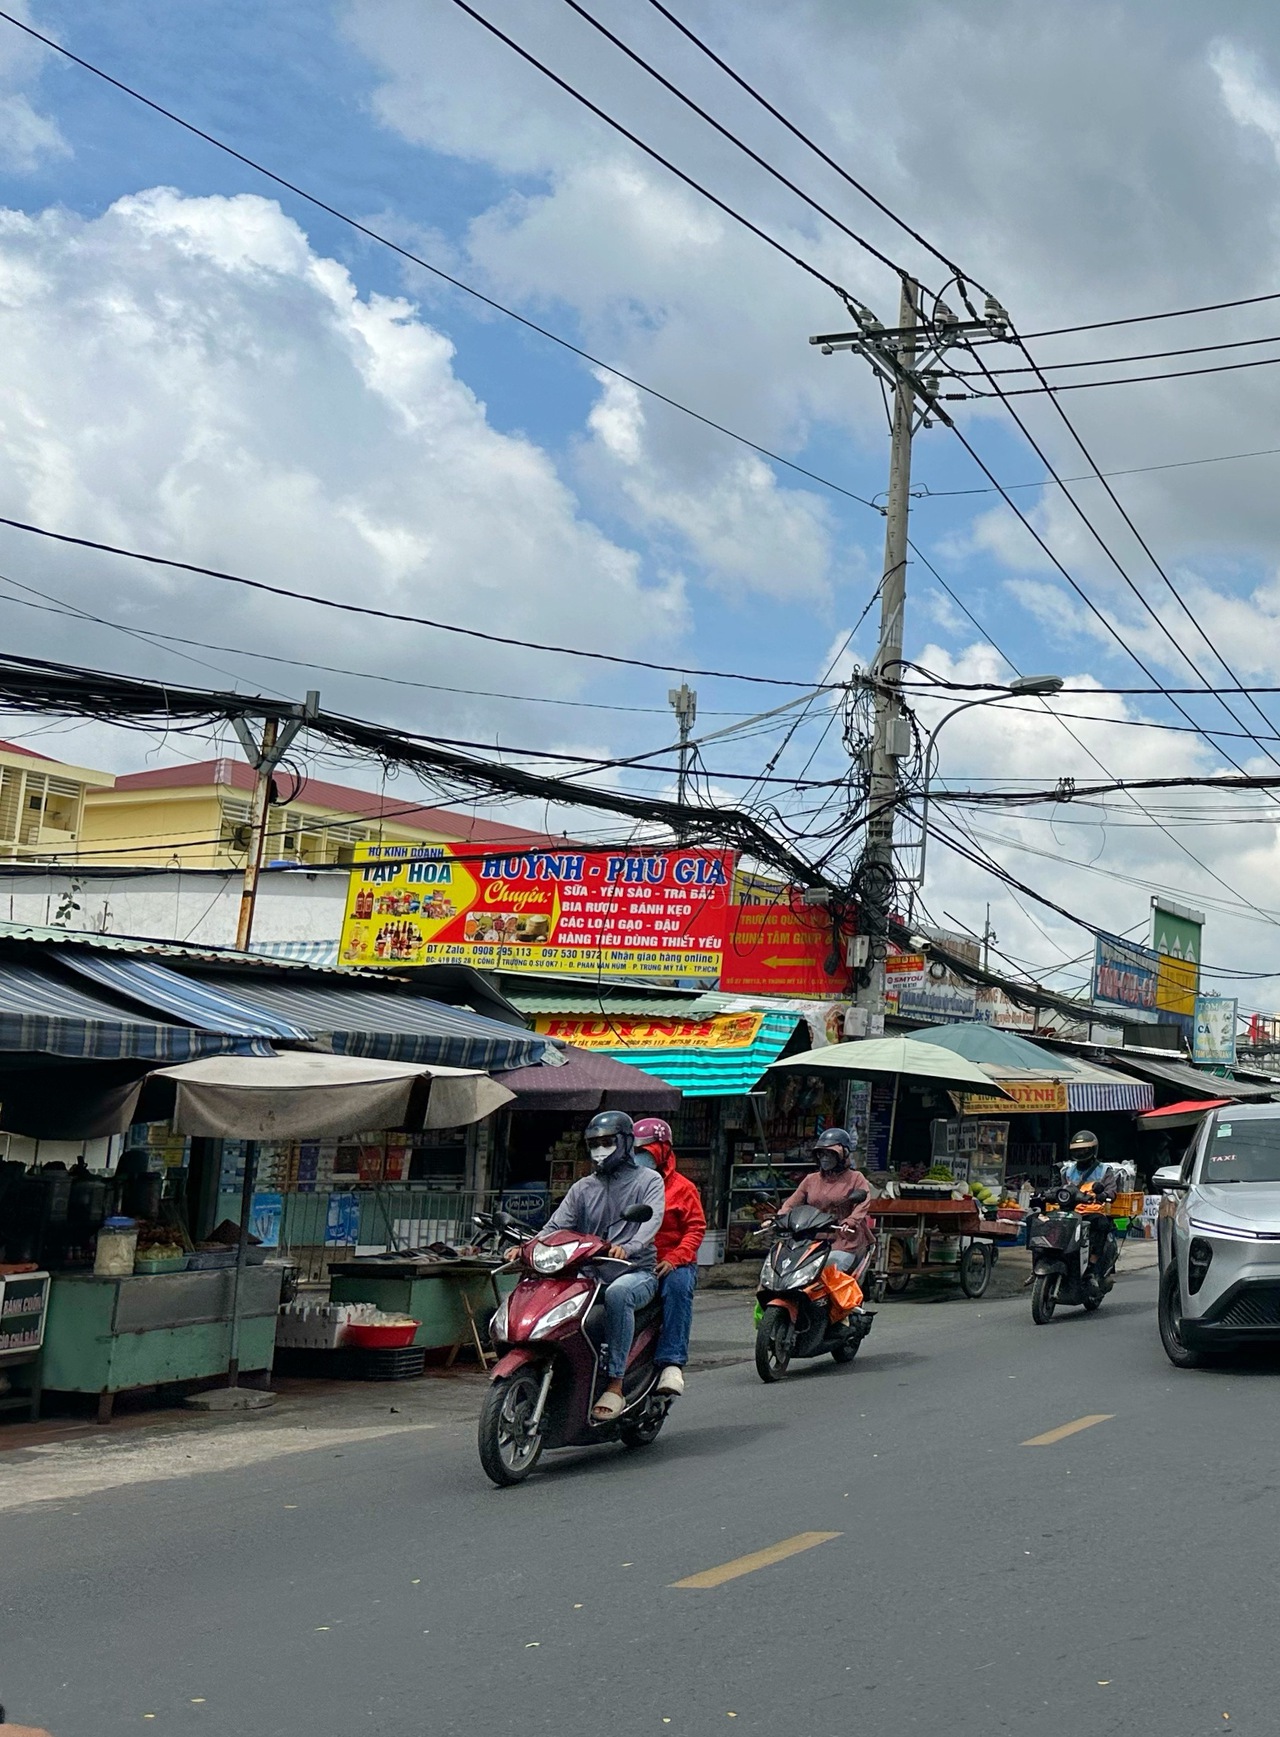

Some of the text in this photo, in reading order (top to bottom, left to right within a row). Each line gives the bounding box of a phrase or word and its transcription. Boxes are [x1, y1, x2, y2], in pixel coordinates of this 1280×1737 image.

[384, 847, 408, 858] KINH
[410, 847, 444, 859] DOANH
[362, 862, 403, 886] TẠP
[481, 847, 586, 882] HUỲNH
[674, 857, 729, 886] GIA
[484, 880, 551, 912] Chuyên:
[563, 883, 588, 897] SỮA
[600, 884, 622, 898] YẾN
[627, 885, 652, 899] SÀO
[663, 886, 687, 900] TRÀ
[562, 901, 692, 918] BIA RƯỢU BÁNH KẸO
[560, 916, 680, 934] CÁC LOẠI GẠO ĐẬU
[558, 931, 722, 949] HÀNG TIÊU DÙNG THIẾT YẾU
[729, 932, 764, 945] TRUNG
[767, 930, 790, 945] TÂM
[427, 945, 713, 963] ĐT Zalo 0908 295 113 097 530 1972 Nhận giao hàng online
[640, 963, 661, 971] TRUNG
[676, 963, 687, 972] TÂY
[694, 965, 718, 973] TP.HCM
[1211, 1154, 1236, 1162] TAXI
